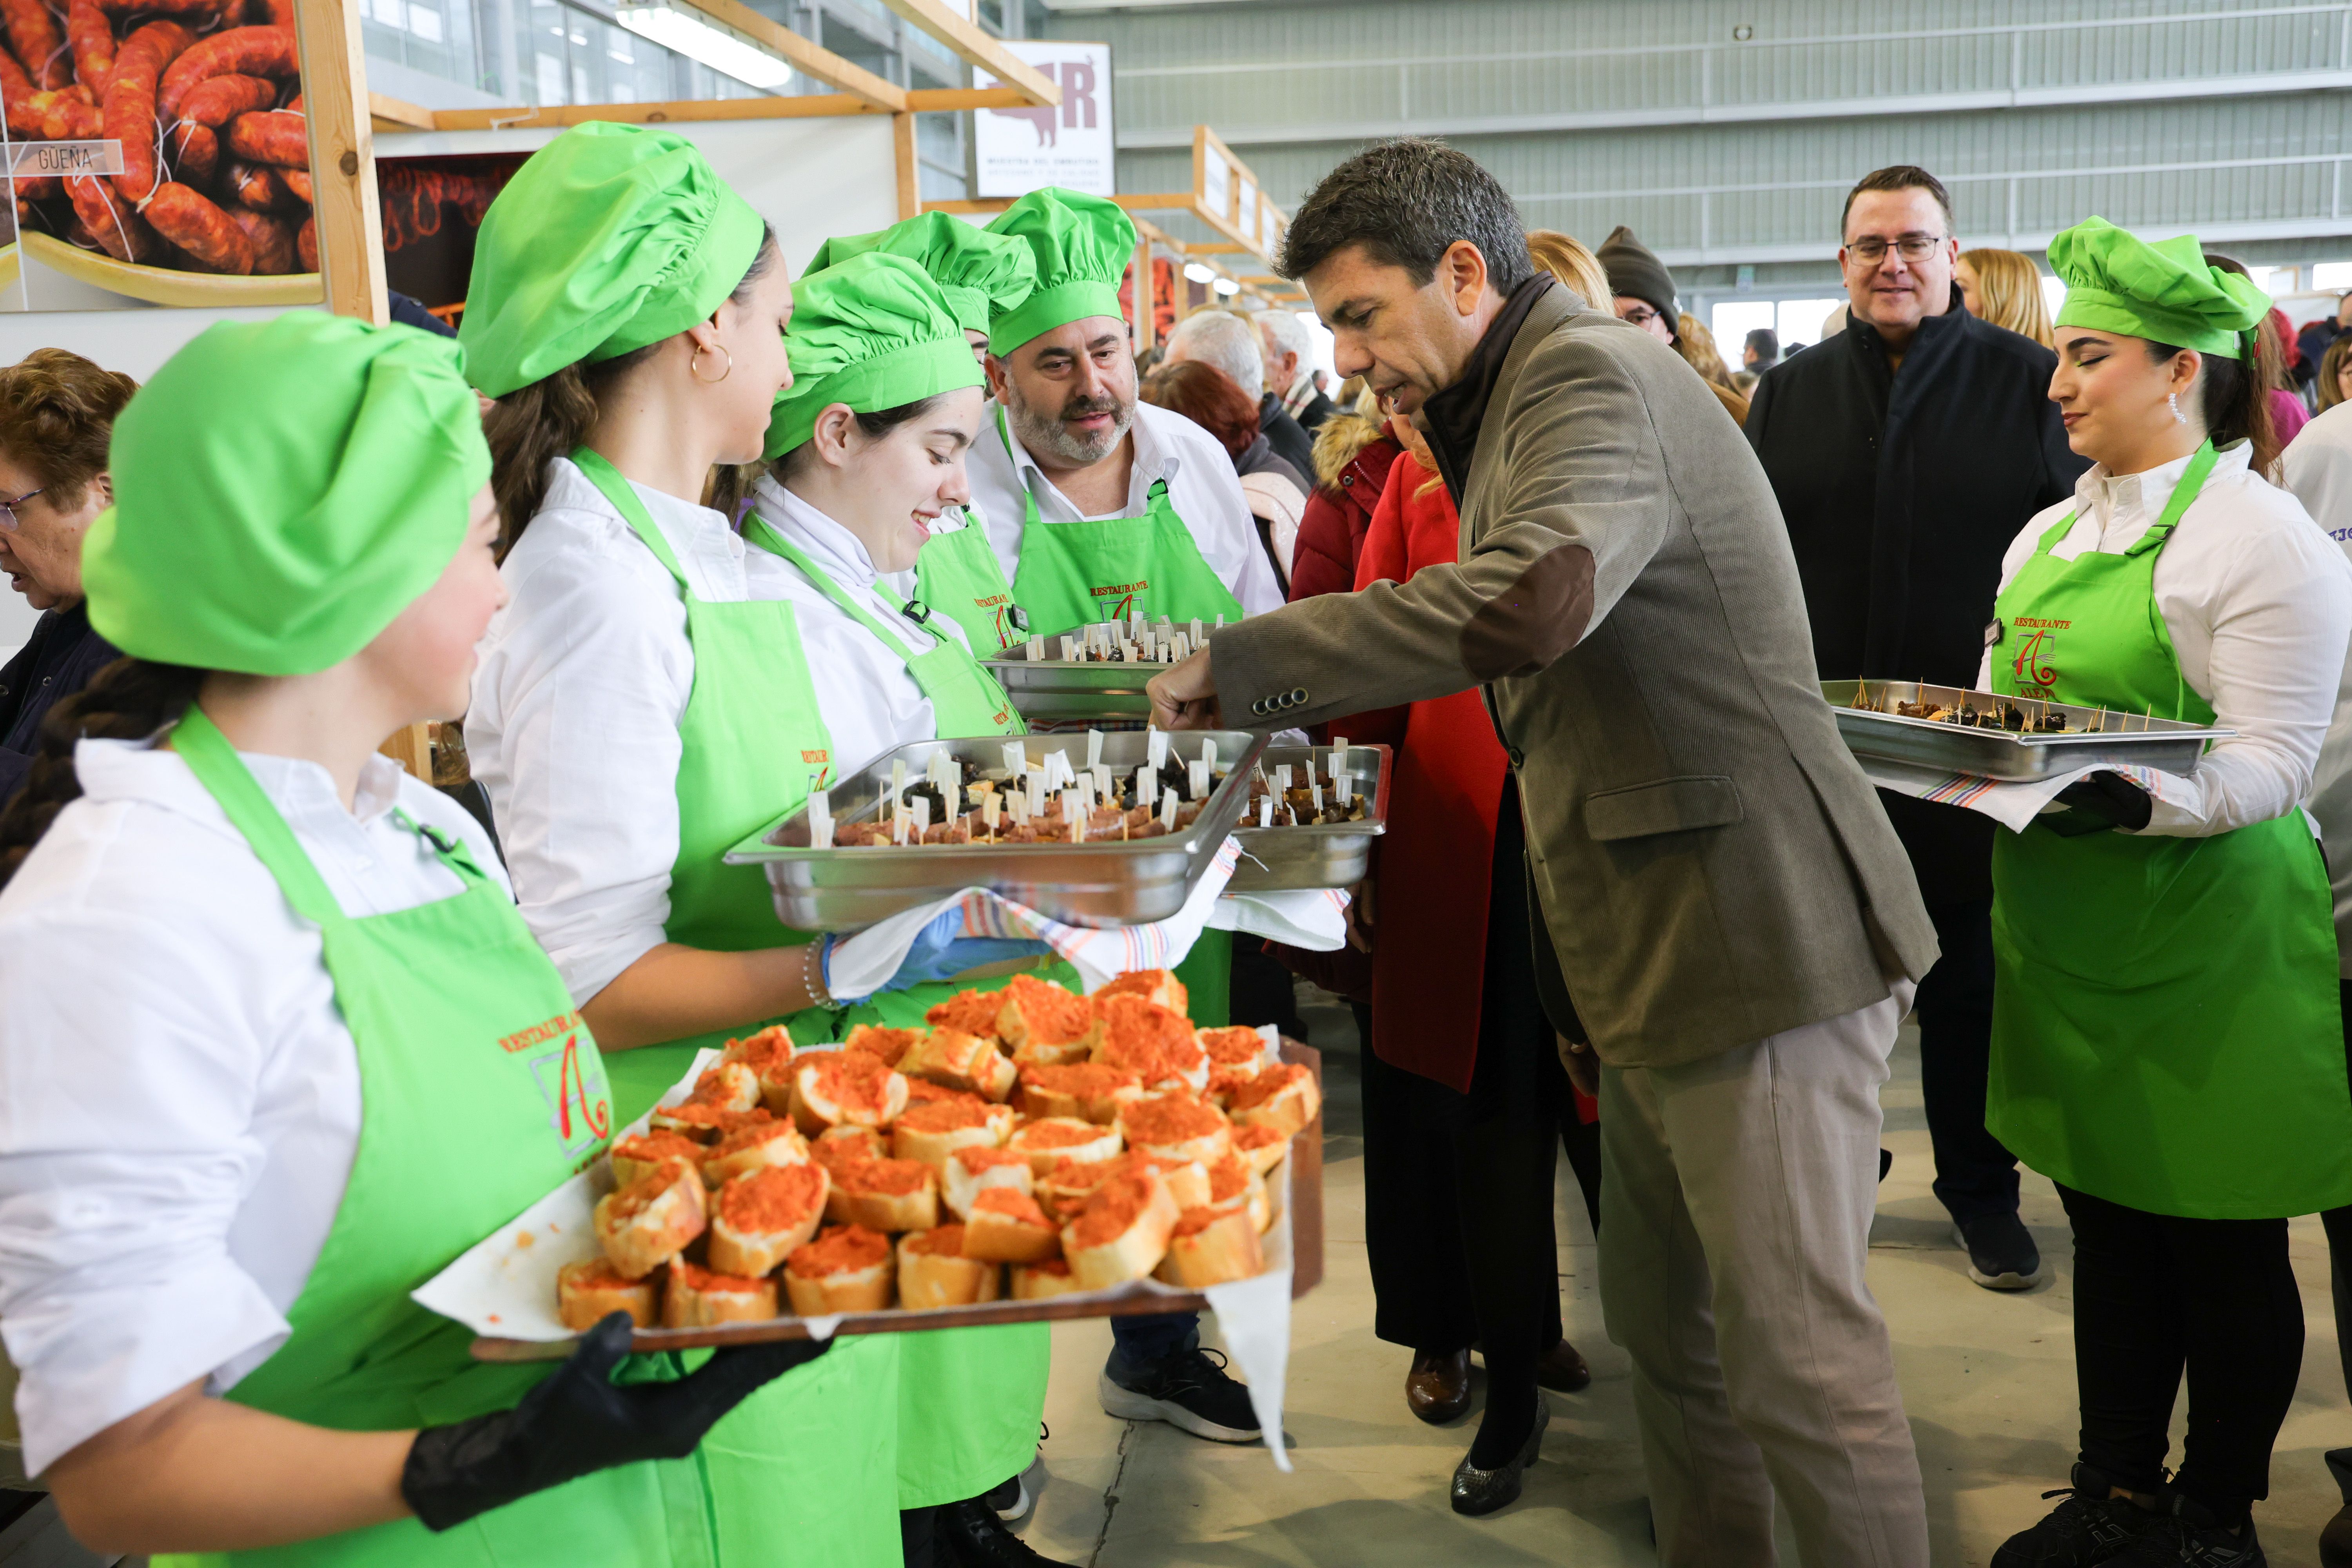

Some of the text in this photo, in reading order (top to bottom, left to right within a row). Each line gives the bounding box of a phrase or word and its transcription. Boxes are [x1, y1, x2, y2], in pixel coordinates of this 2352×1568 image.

[38, 145, 93, 169] GÜEÑA
[1090, 580, 1149, 596] RESTAURANTE
[2013, 617, 2072, 630] RESTAURANTE
